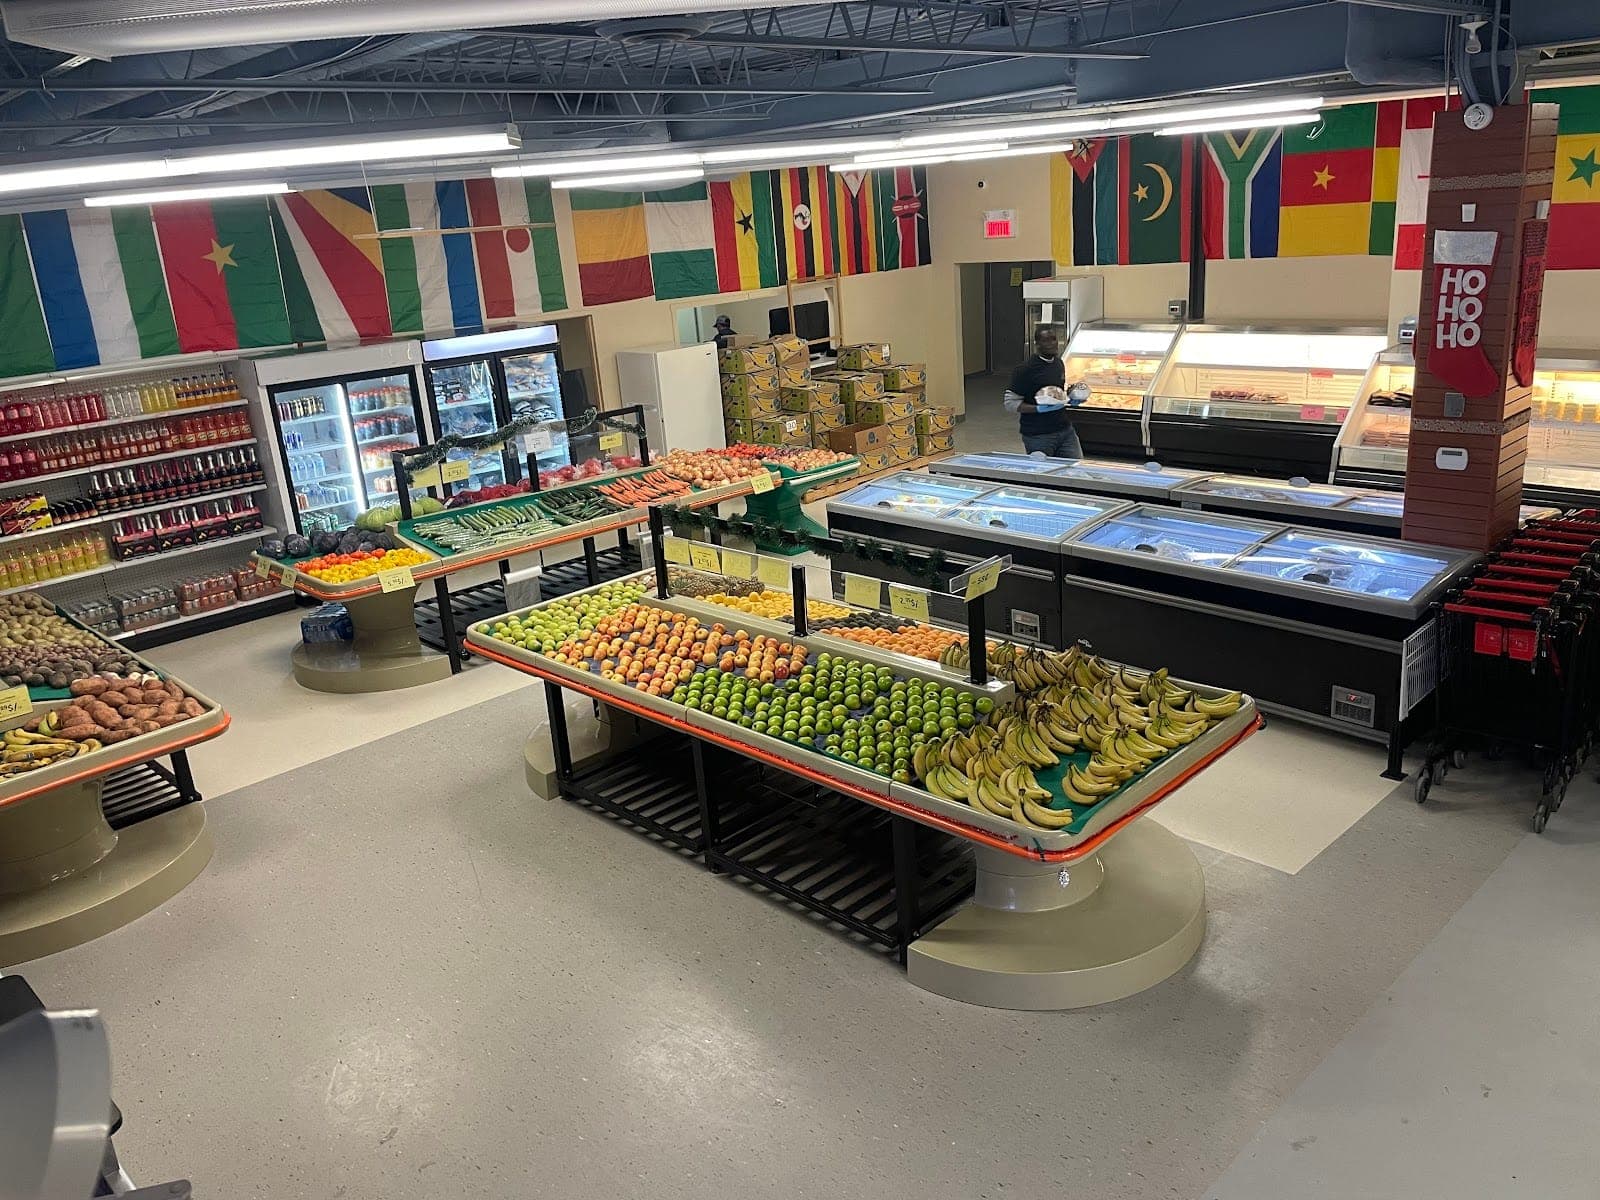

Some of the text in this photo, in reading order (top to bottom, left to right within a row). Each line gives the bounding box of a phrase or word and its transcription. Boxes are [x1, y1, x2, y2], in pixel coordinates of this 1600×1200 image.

[1440, 268, 1486, 295] HO
[1437, 295, 1483, 322] HO
[1436, 322, 1481, 349] HO
